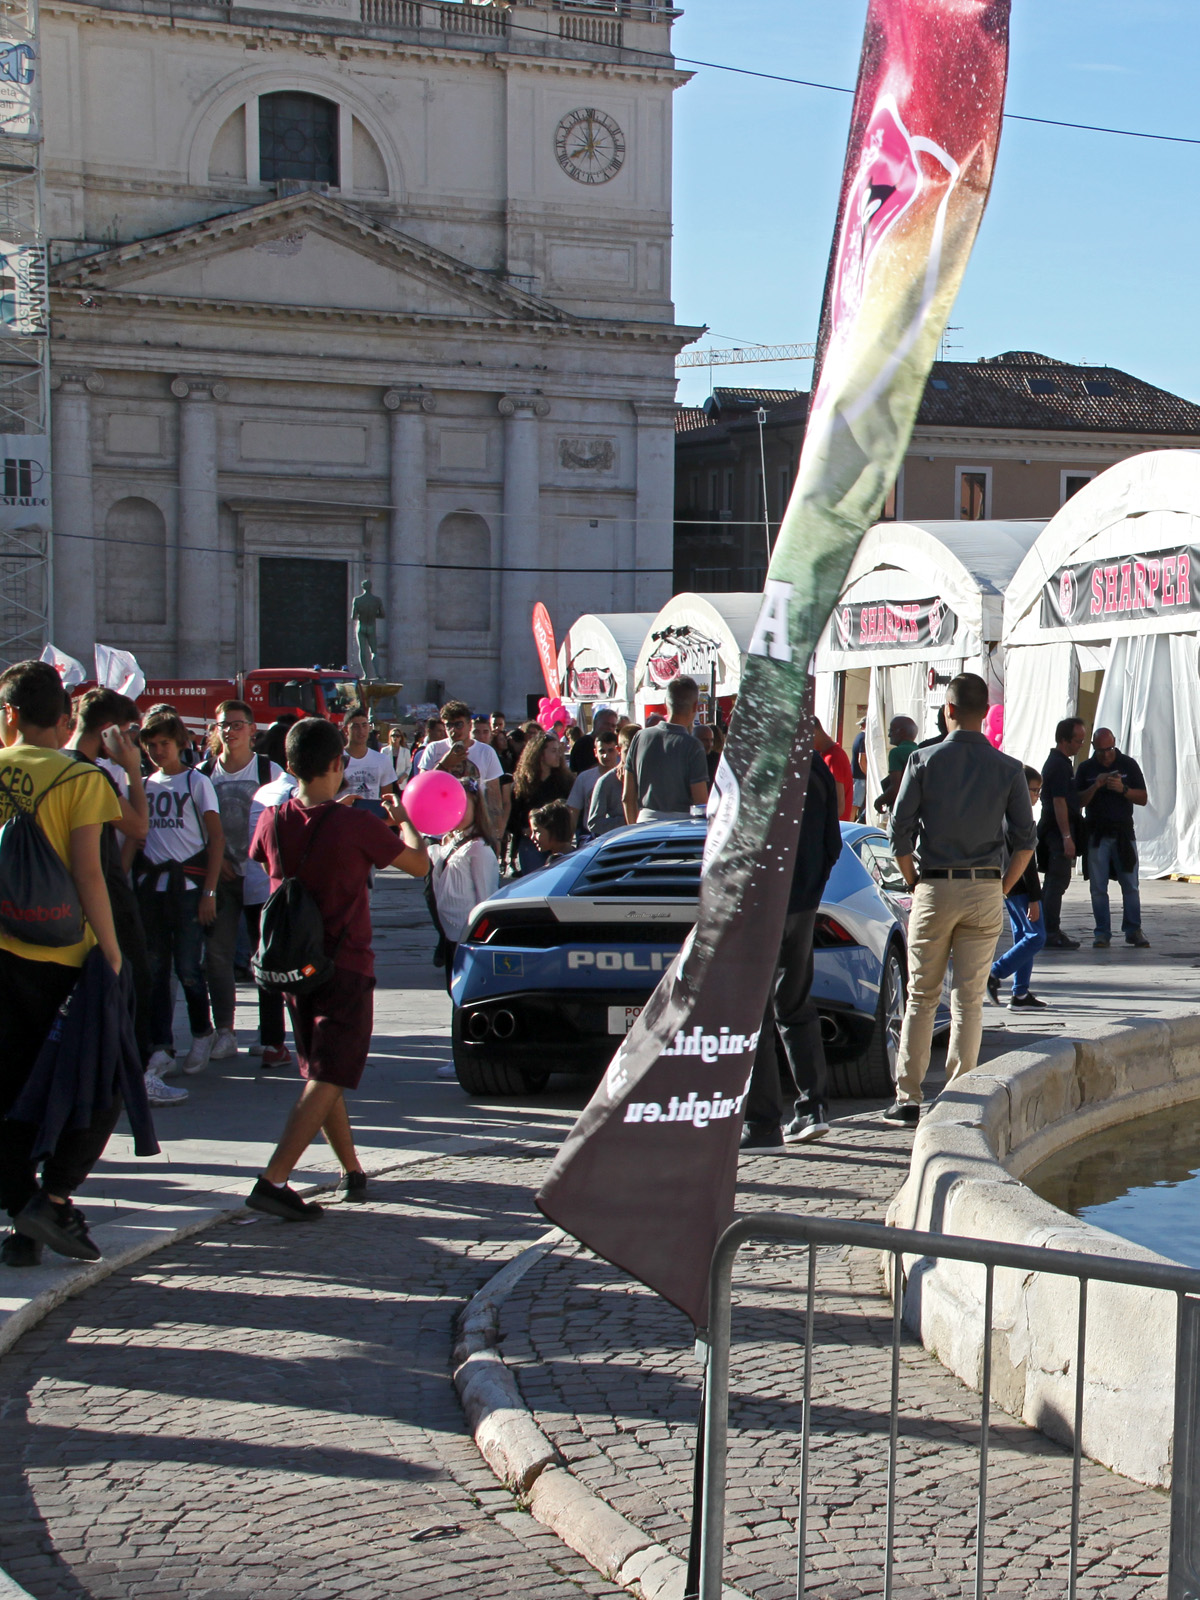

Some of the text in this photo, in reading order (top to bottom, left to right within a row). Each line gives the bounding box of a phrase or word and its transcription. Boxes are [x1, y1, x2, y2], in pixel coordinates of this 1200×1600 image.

[28, 246, 48, 336] IANNINI
[1090, 553, 1191, 616] SHARPER
[859, 604, 921, 645] SHARPER
[159, 687, 176, 696] DEL
[180, 687, 207, 696] FUOCO
[271, 971, 288, 983] DO
